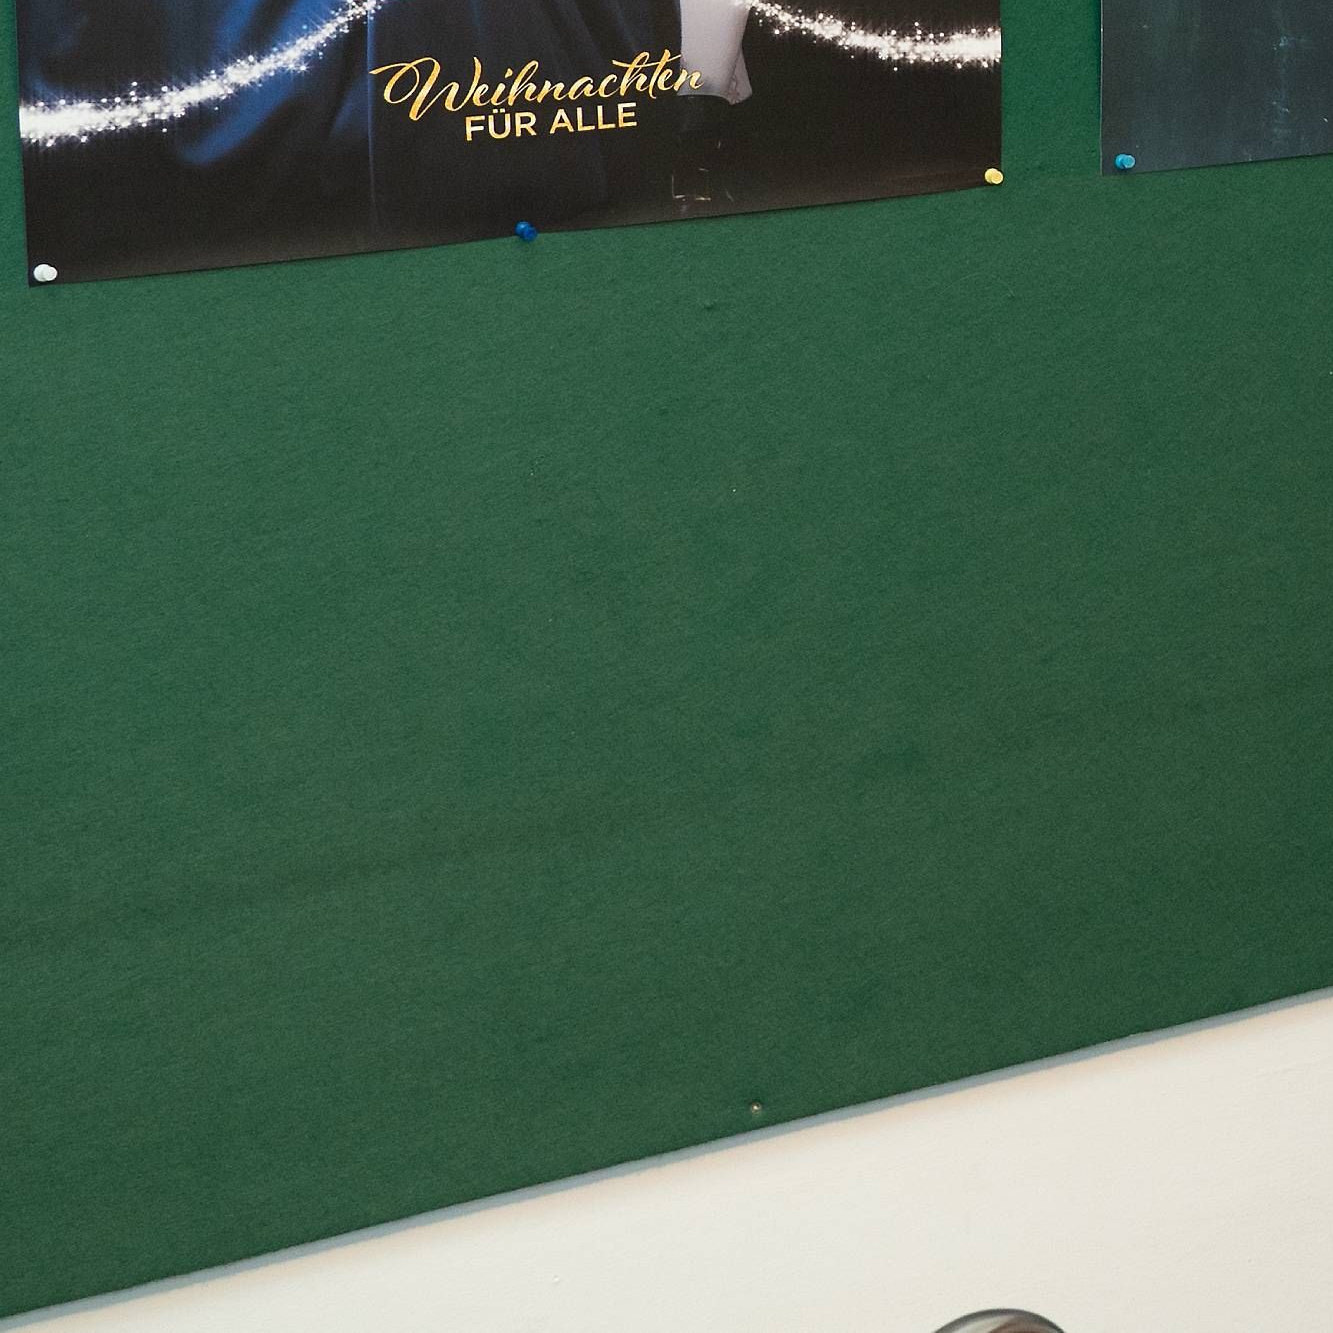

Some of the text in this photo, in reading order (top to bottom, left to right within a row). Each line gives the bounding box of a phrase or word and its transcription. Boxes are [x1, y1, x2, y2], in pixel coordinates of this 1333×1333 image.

[368, 48, 706, 122] Weihnachten
[465, 102, 638, 141] FÜR ALLE
